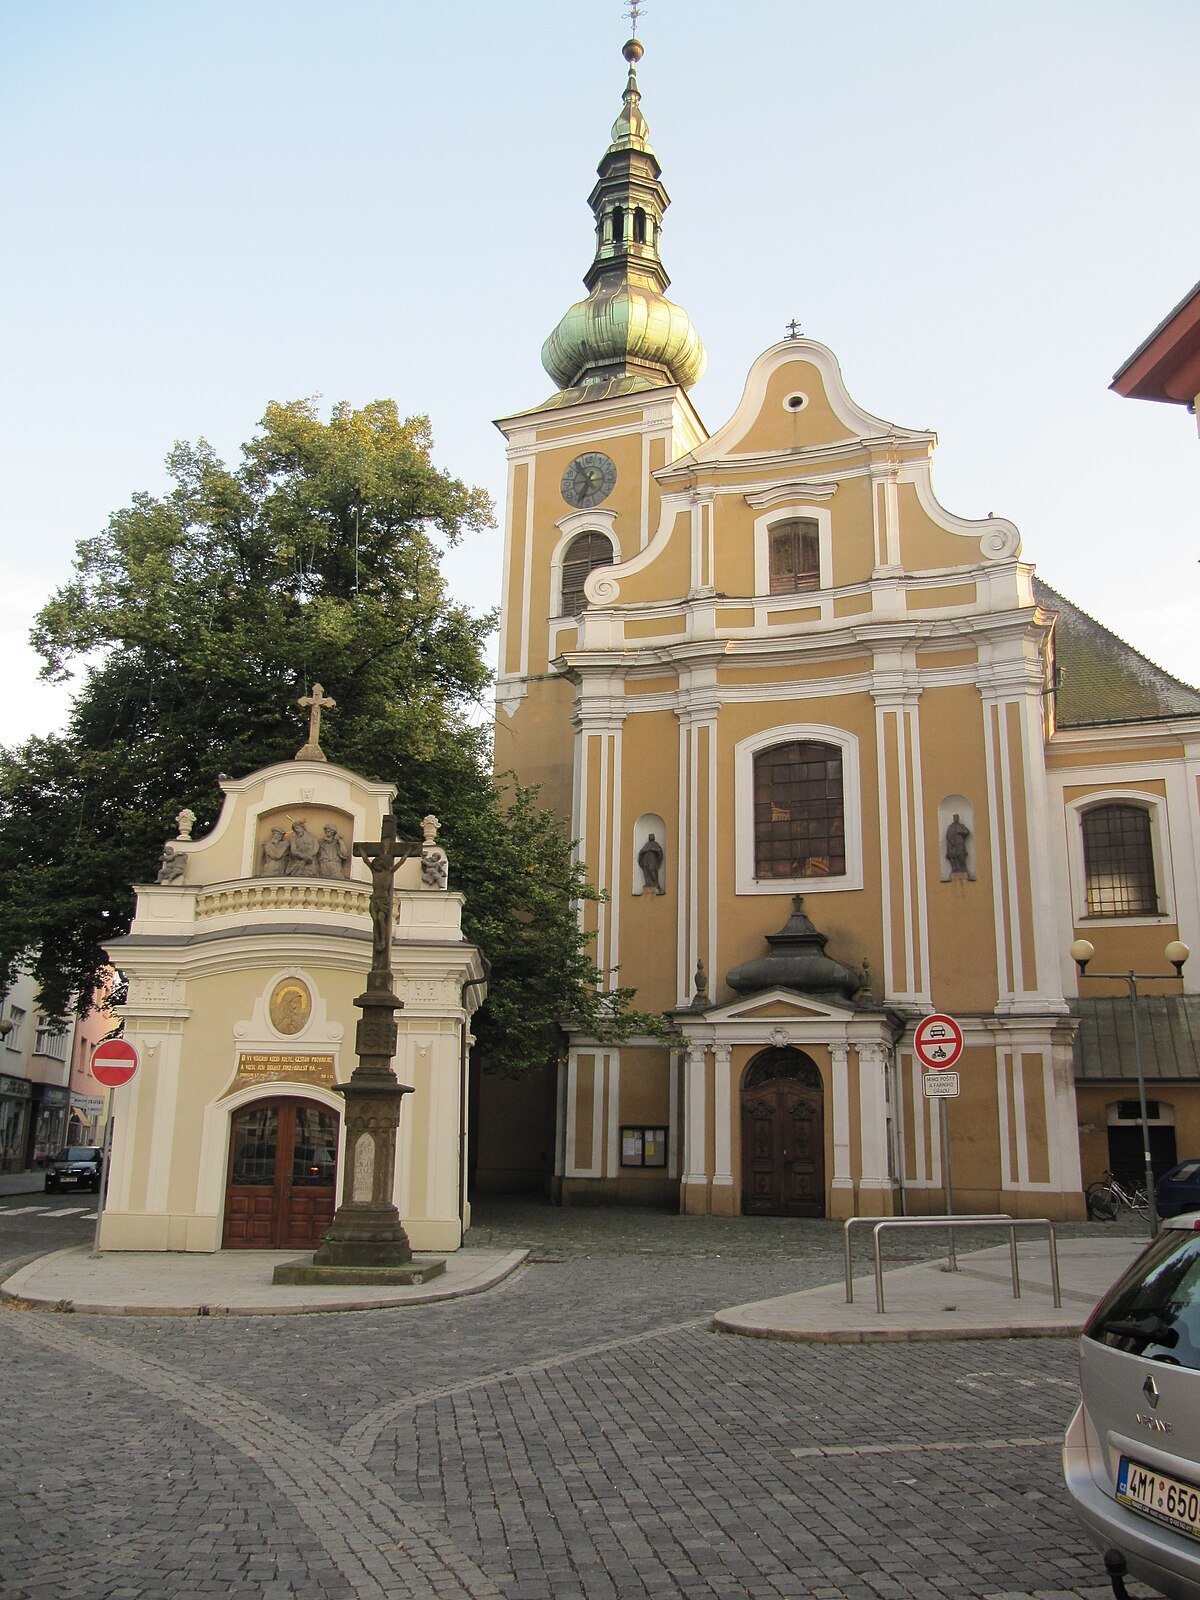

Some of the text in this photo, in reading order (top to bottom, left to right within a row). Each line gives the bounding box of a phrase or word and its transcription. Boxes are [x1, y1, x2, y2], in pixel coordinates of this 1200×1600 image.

[1120, 1482, 1127, 1492] CZ
[1130, 1469, 1200, 1524] 4M1 650
